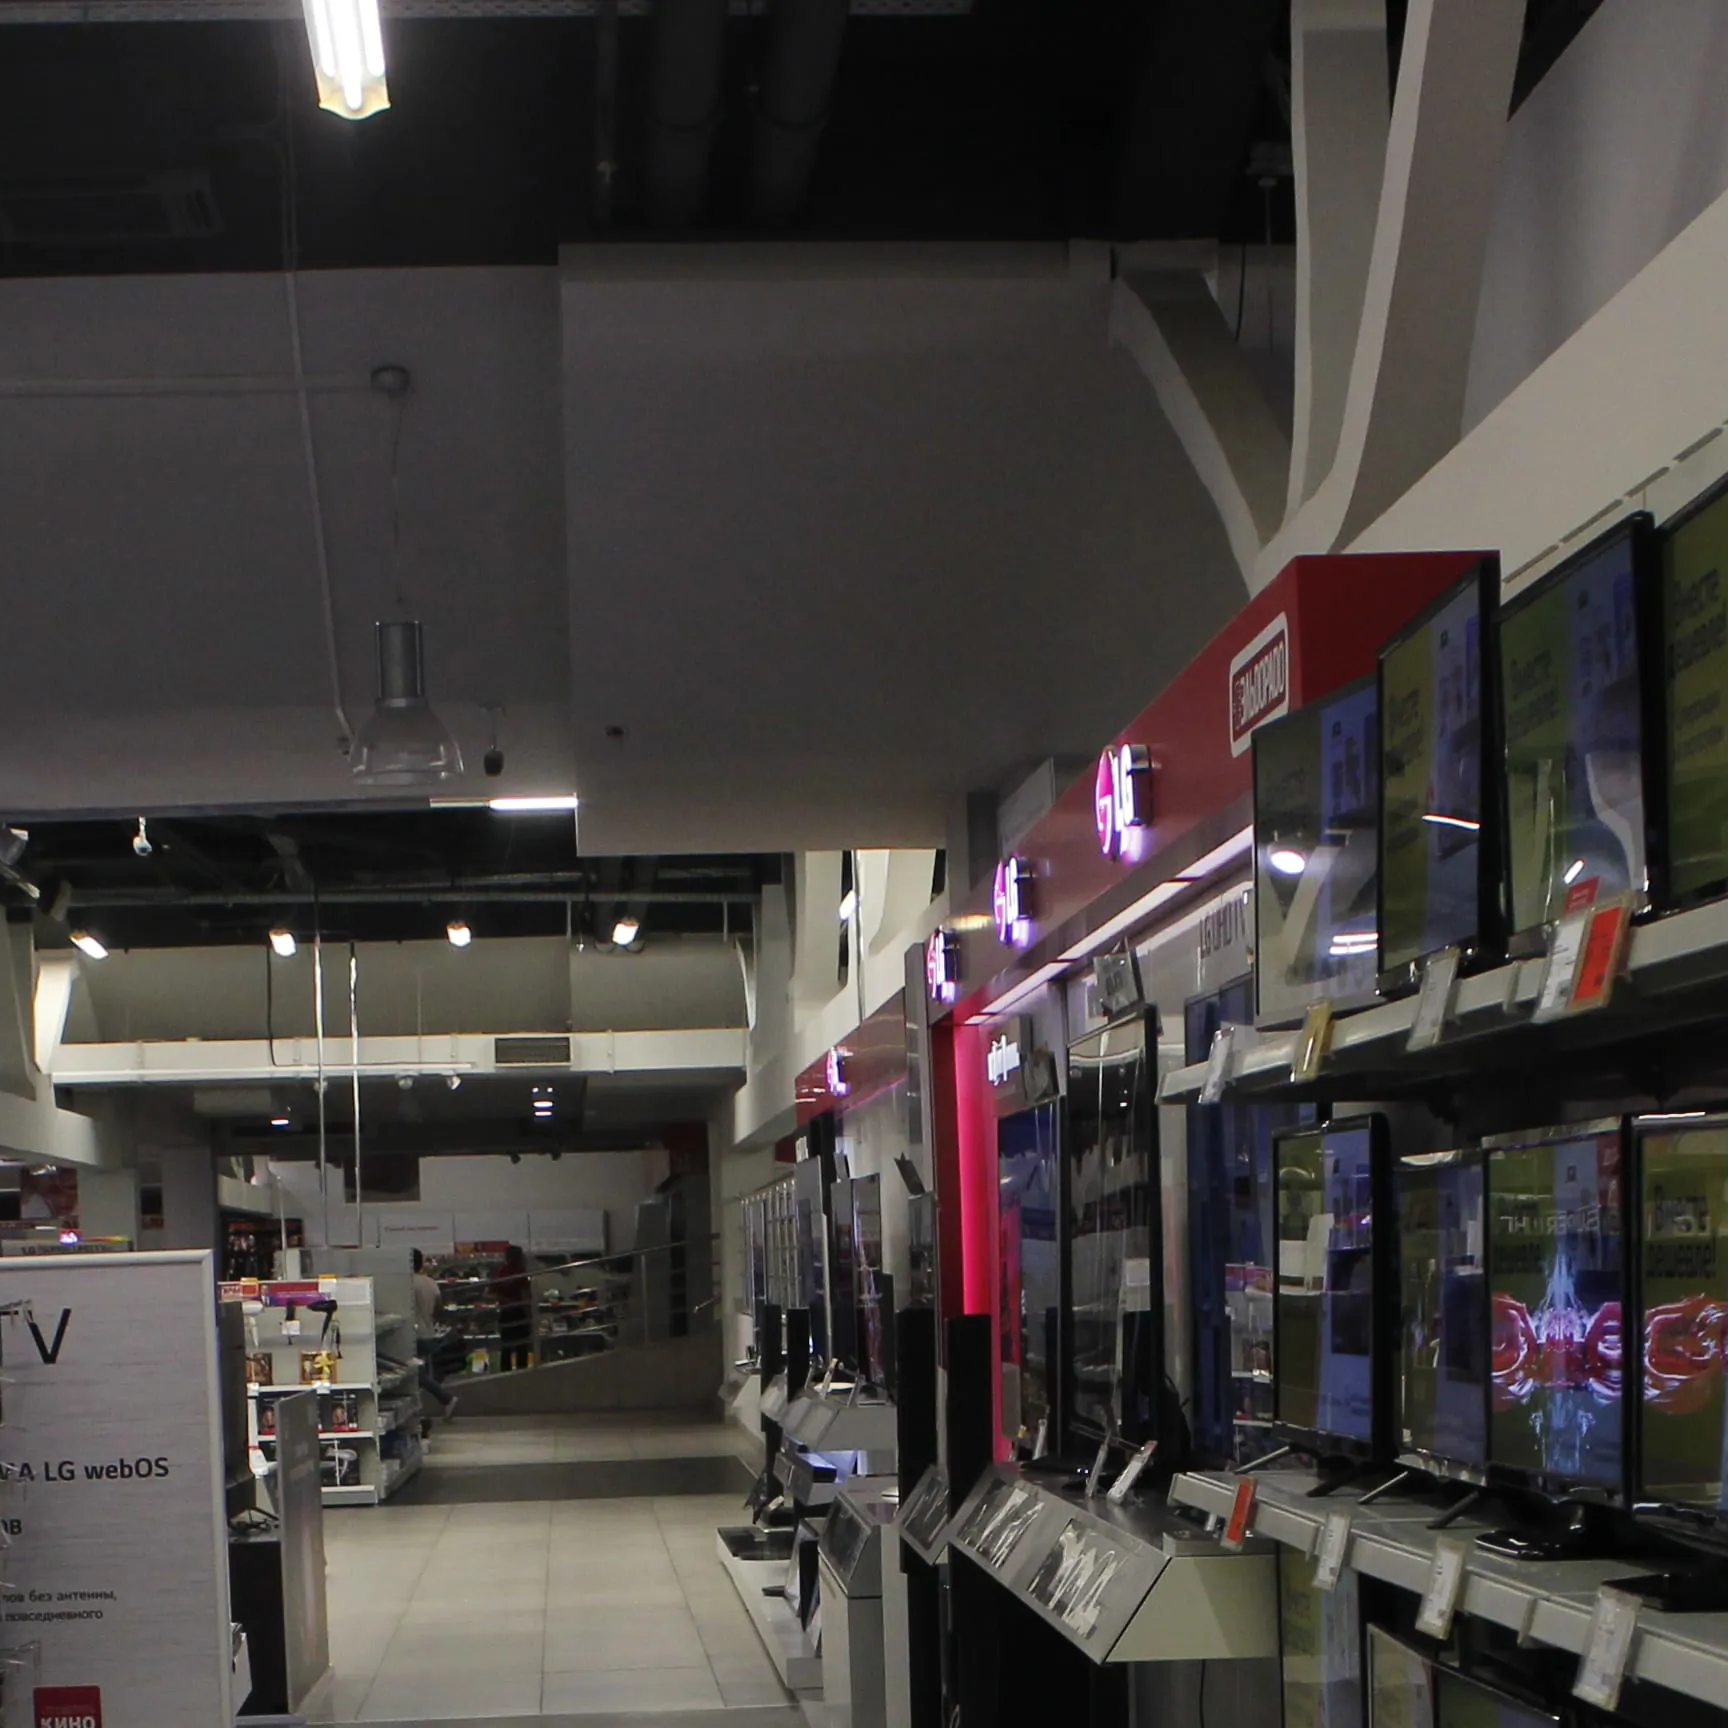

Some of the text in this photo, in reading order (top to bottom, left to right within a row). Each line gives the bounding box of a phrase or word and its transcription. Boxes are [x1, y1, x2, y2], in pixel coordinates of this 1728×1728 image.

[43, 1461, 76, 1482] LG
[84, 1457, 170, 1481] webOS
[29, 1589, 53, 1602] без
[57, 1590, 118, 1602] антенны,
